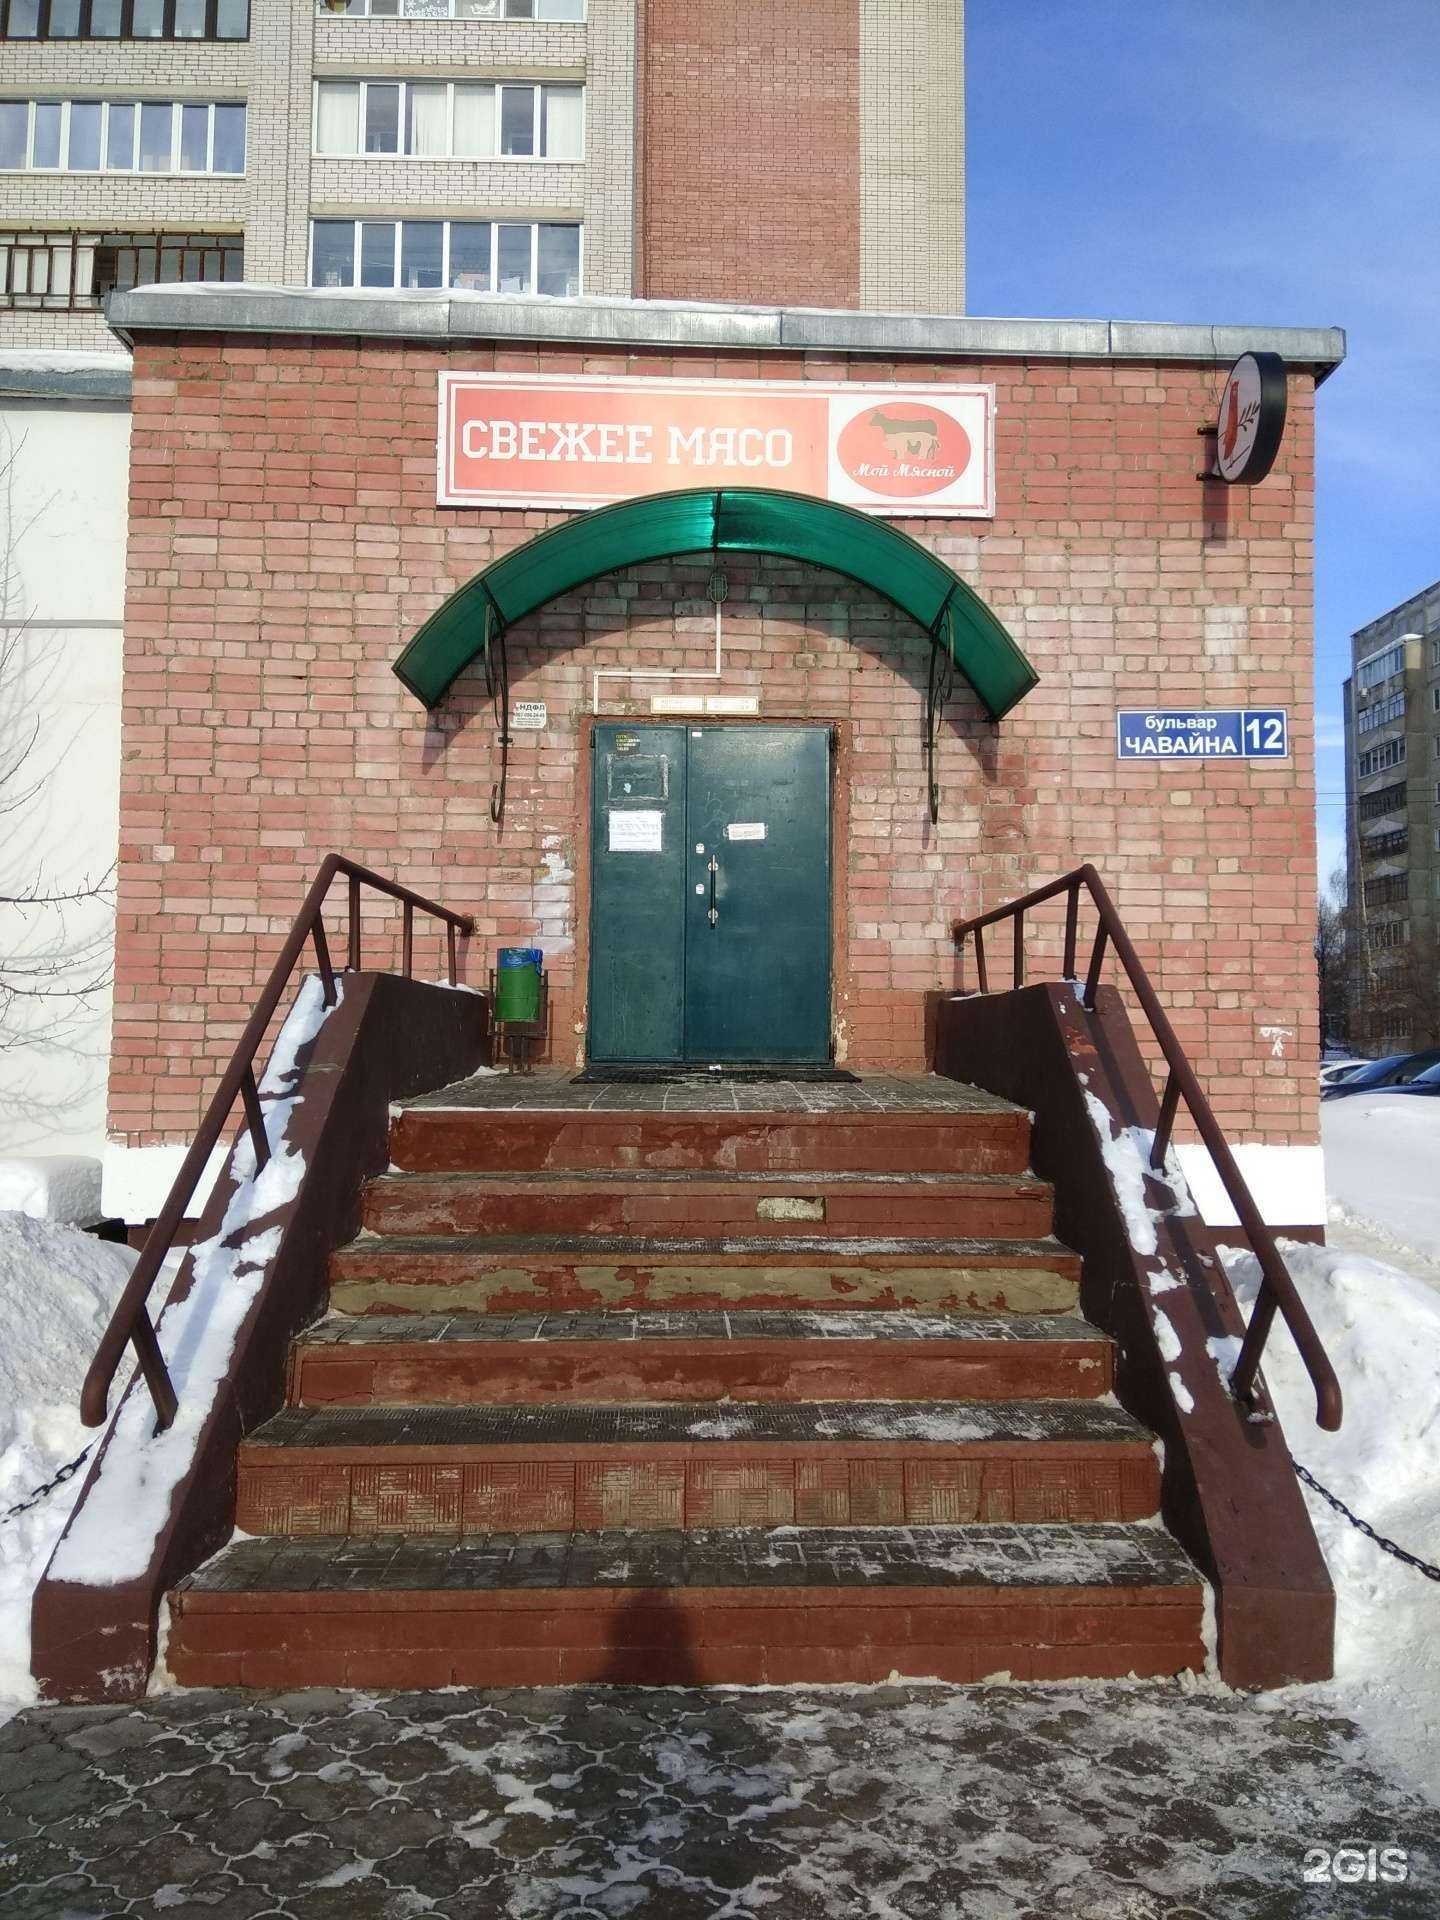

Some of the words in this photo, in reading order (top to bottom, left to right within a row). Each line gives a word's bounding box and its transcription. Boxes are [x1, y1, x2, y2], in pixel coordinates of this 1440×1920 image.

[462, 419, 653, 464] СВЕЖЕЕ
[666, 426, 793, 467] МЯСО
[852, 463, 889, 477] Мой
[893, 463, 956, 478] Мясной
[1145, 714, 1218, 732] бульвар
[1246, 718, 1284, 750] 12
[1125, 732, 1238, 755] ЧАВАЙНА
